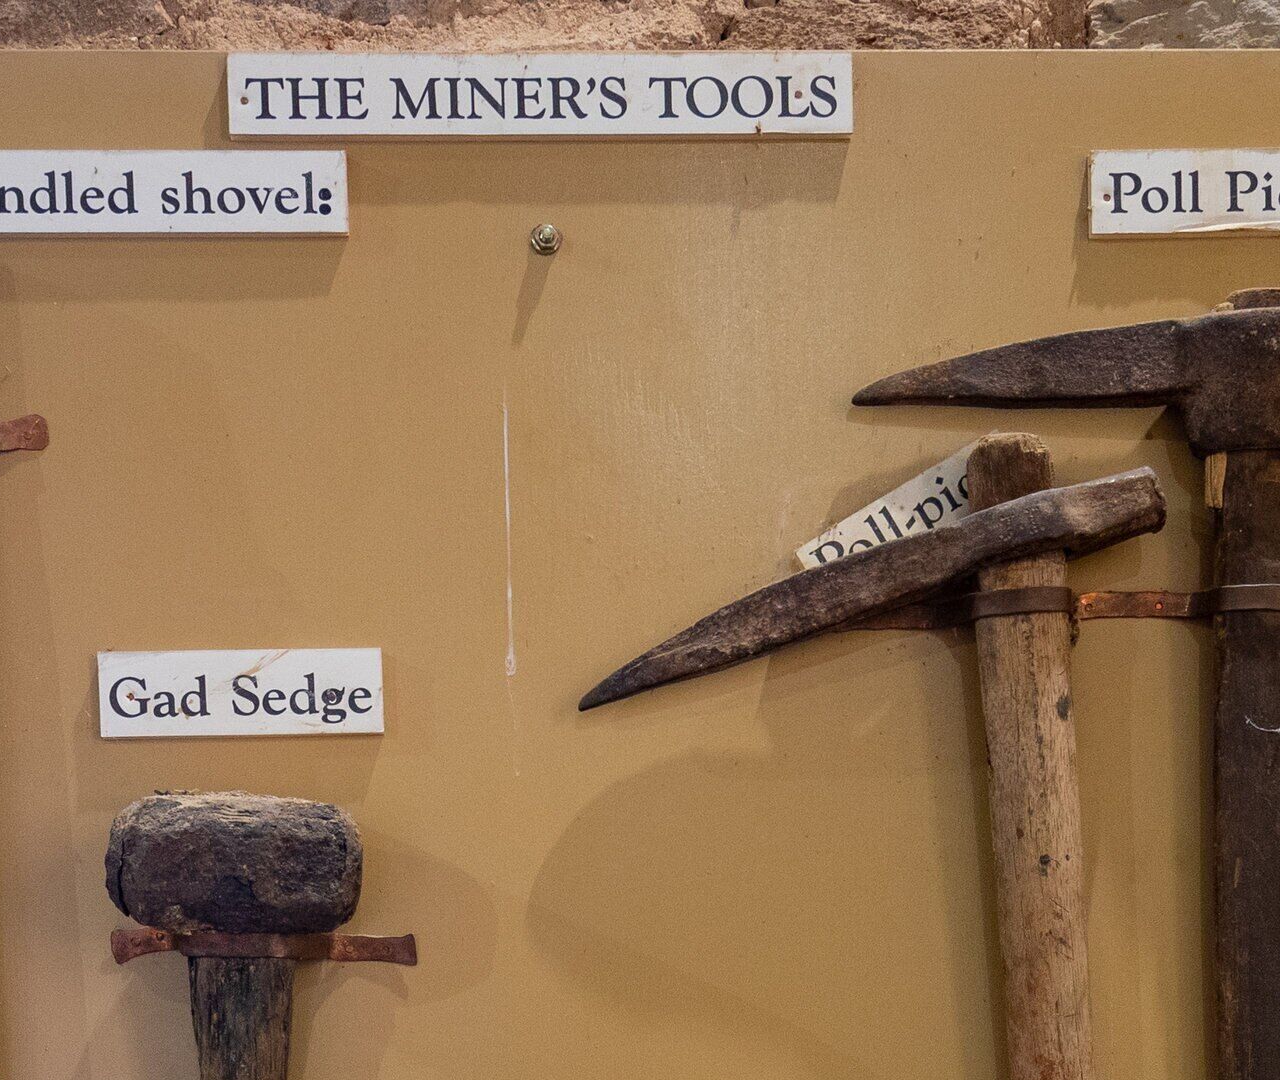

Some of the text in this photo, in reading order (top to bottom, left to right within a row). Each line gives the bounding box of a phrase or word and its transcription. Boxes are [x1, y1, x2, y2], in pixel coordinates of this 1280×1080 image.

[245, 75, 838, 120] THE MINER'S TOOLS
[1109, 170, 1203, 214] Poll
[109, 672, 373, 724] Gad Sedge
